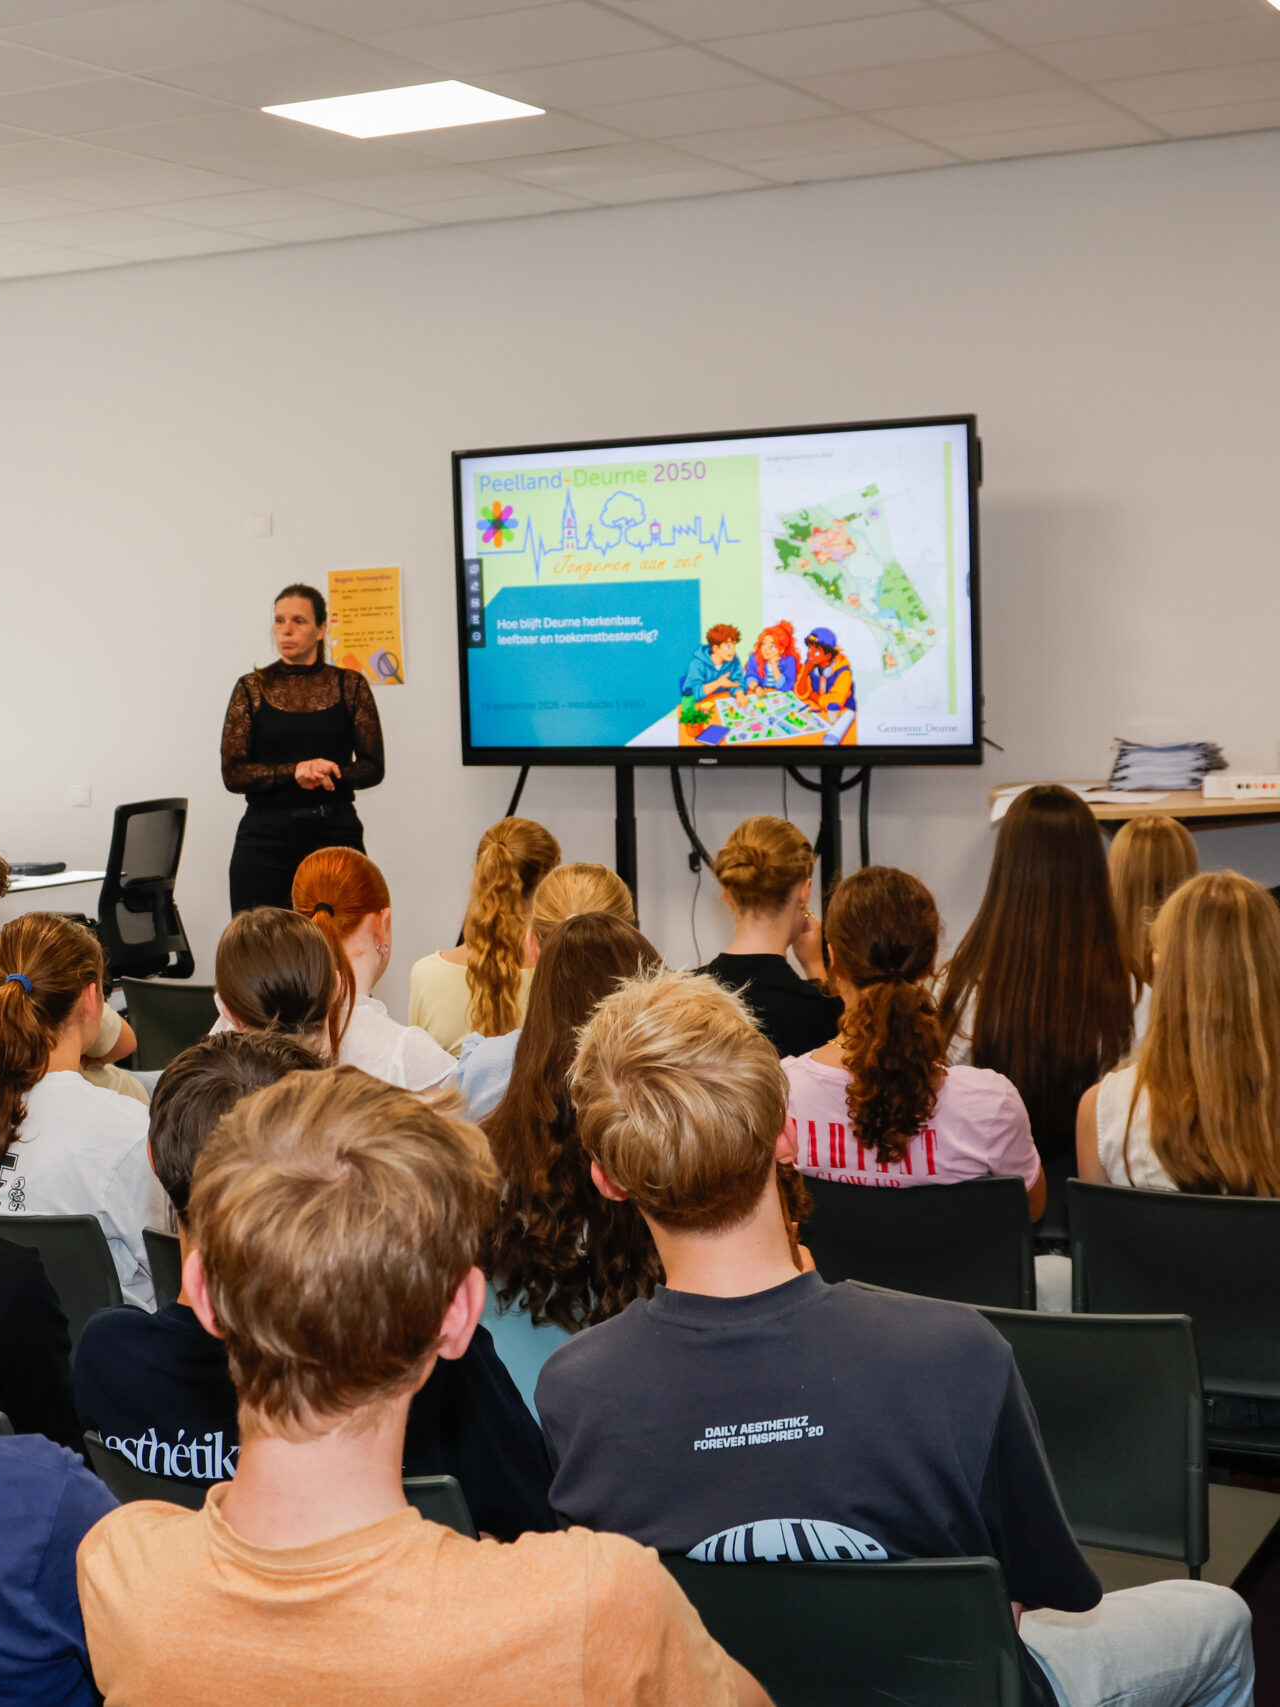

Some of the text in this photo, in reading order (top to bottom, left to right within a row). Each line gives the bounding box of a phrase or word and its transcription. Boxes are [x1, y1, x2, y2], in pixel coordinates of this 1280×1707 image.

[654, 461, 706, 482] 2050
[553, 553, 703, 580] Jongeren aan zet
[497, 615, 643, 631] Hoe blijft Deurne herkenbaar,
[497, 629, 659, 645] leefbaar en toekomstbestendig?
[878, 723, 959, 732] Gemeente Deurne
[705, 1415, 809, 1438] DAILY AESTHETIKZ
[694, 1436, 746, 1451] FOREVER
[748, 1428, 803, 1445] INSPIRED
[99, 1427, 241, 1479] esthétik
